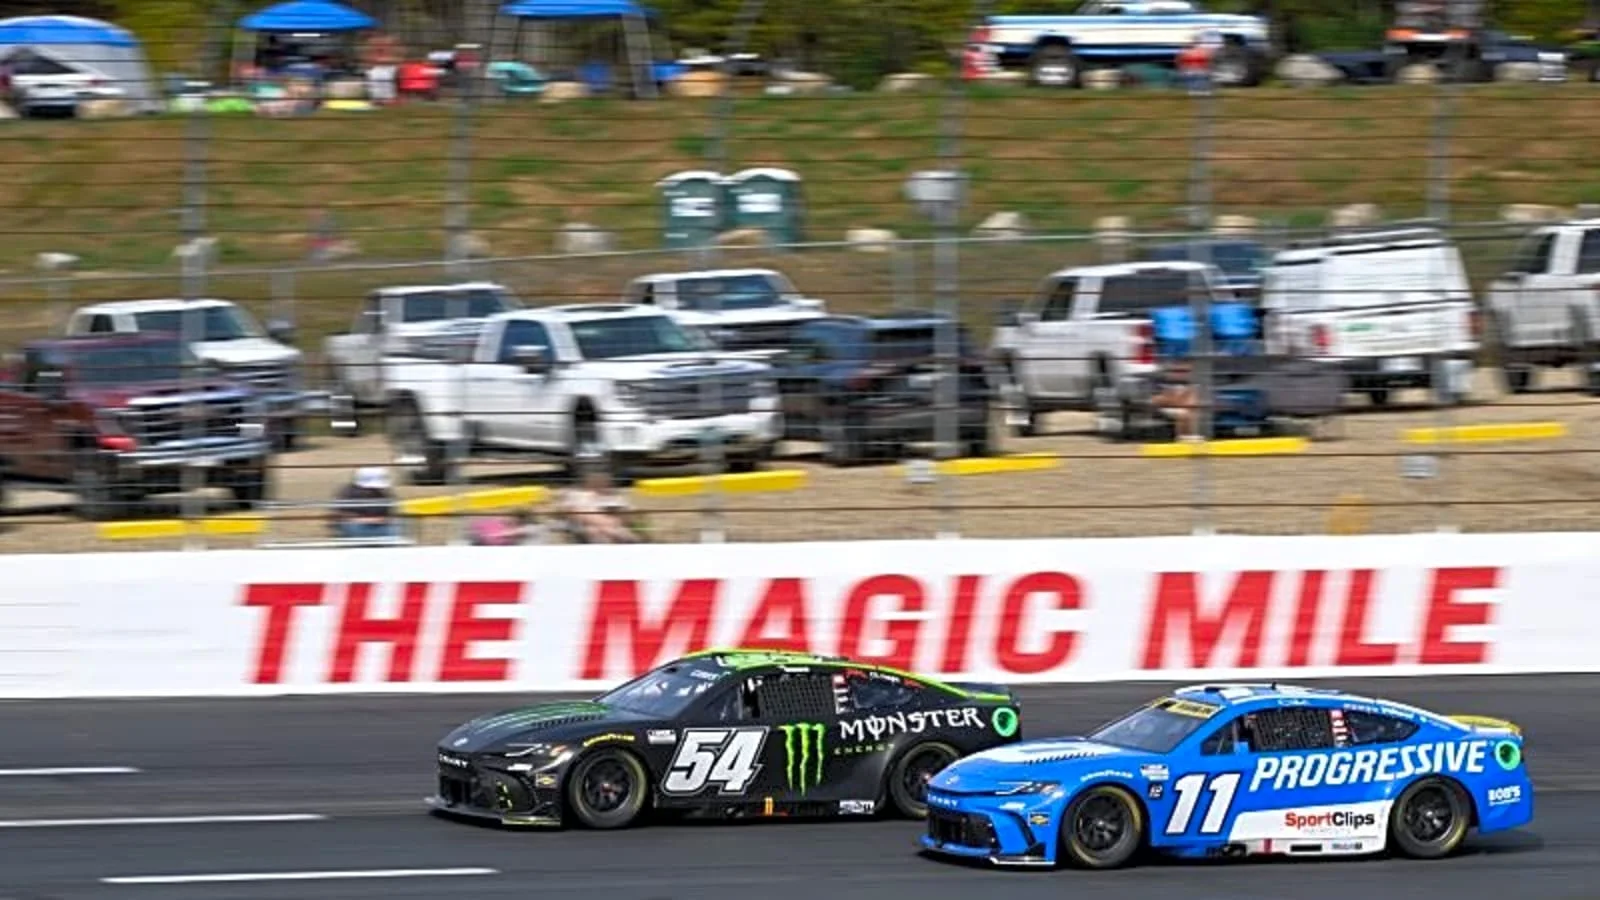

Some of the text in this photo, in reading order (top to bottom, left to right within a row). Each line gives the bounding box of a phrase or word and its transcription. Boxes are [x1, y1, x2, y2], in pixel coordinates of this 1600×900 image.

[240, 566, 1506, 684] THE MAGIC MILE
[839, 706, 985, 742] MONSTER
[662, 727, 768, 795] 54
[1249, 739, 1488, 793] PROGRESSIVE
[1165, 773, 1241, 835] 11
[1284, 811, 1376, 830] SportClips
